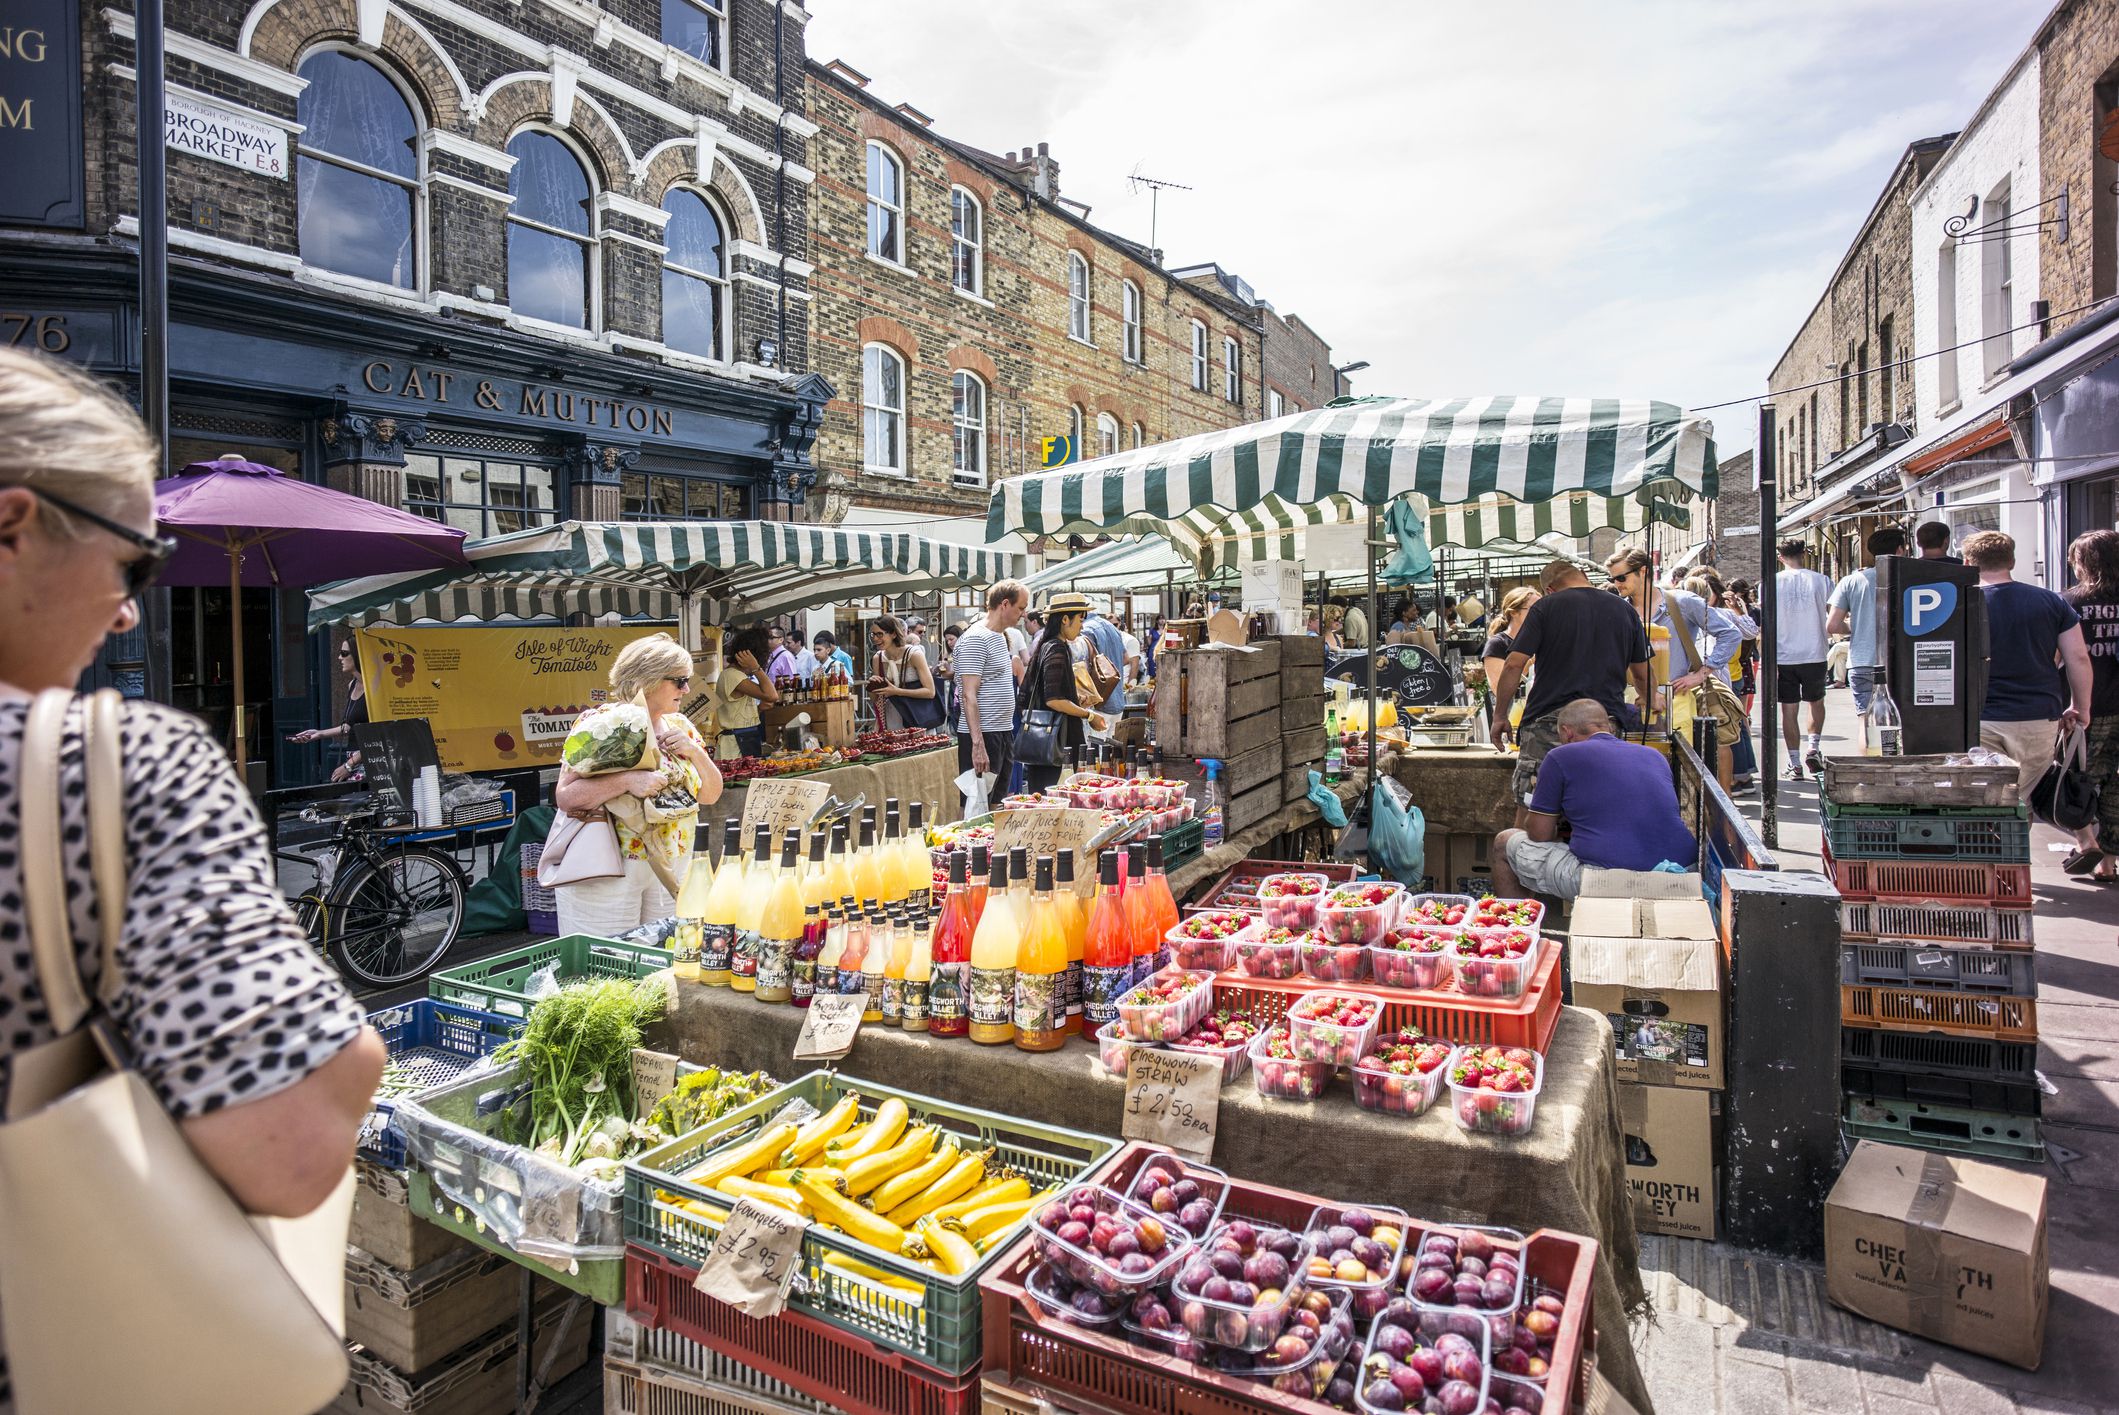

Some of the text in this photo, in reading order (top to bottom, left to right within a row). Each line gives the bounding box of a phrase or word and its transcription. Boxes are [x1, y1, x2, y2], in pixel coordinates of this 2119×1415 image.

[171, 99, 272, 136] BOROUGH OF HACKNEY
[164, 109, 277, 155] BROADWAY
[2, 313, 71, 354] 76
[364, 361, 673, 436] CAT & MUTTON
[1911, 588, 1942, 627] P
[515, 637, 613, 660] Isle of Wight
[530, 656, 598, 675] Tomatoes
[528, 715, 541, 723] The
[1003, 813, 1029, 833] Apple
[1032, 813, 1060, 830] Juice
[1090, 1010, 1116, 1019] VALLEY
[1136, 1066, 1188, 1087] STRAW
[1688, 1070, 1711, 1080] juices
[735, 1198, 788, 1236] Courgettes
[1679, 1221, 1702, 1232] juices
[1855, 1271, 1876, 1284] hand
[1968, 1306, 1995, 1320] juices
